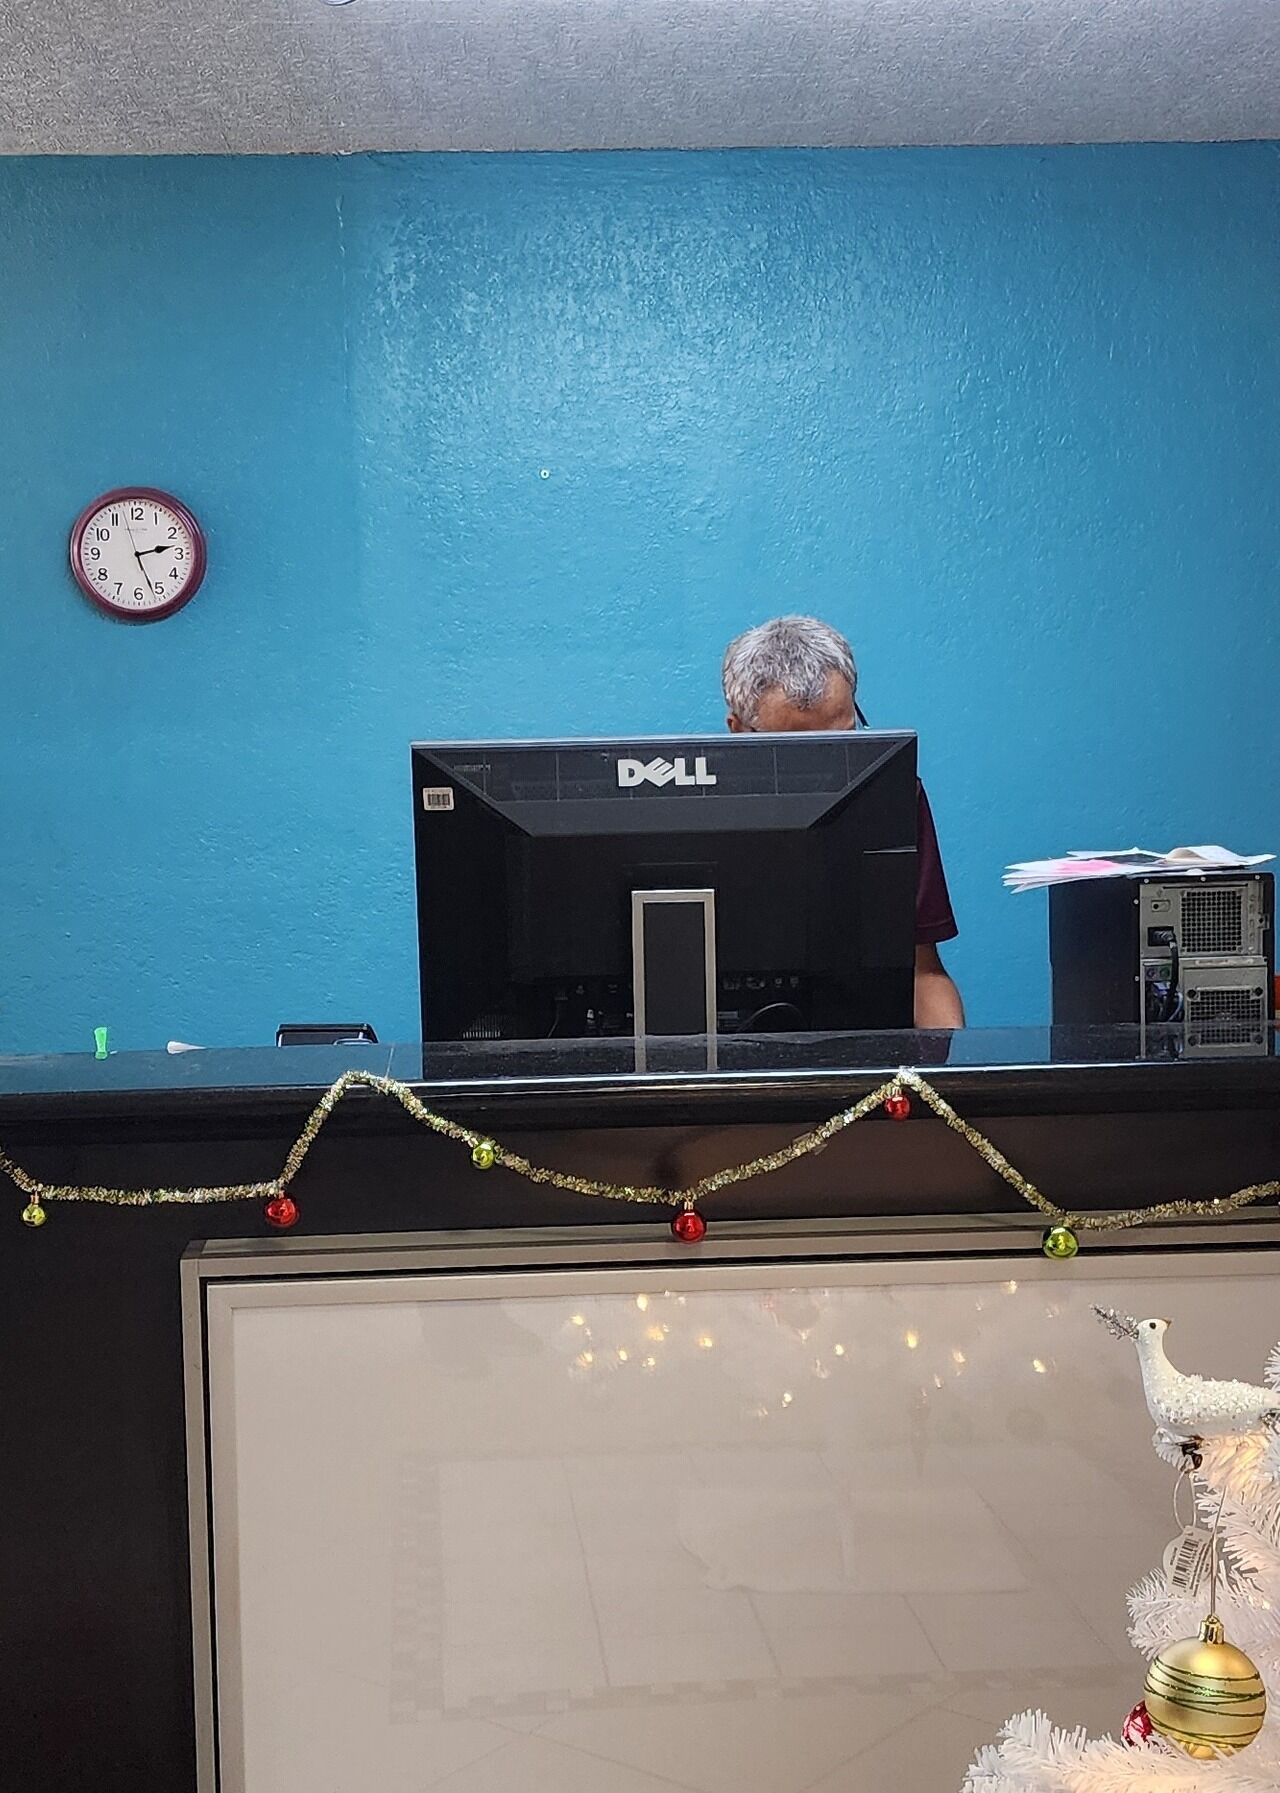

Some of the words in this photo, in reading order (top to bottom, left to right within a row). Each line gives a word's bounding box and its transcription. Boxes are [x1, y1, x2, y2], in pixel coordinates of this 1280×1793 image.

[112, 513, 118, 526] 11
[131, 508, 144, 520] 12
[154, 512, 157, 525] 1
[96, 528, 110, 541] 10
[168, 527, 177, 539] 2
[90, 547, 100, 560] 9
[174, 548, 184, 560] 3
[98, 568, 108, 580] 8
[169, 567, 178, 579] 4
[114, 583, 123, 595] 7
[134, 588, 143, 600] 6
[154, 582, 164, 594] 5
[617, 756, 717, 787] DELL
